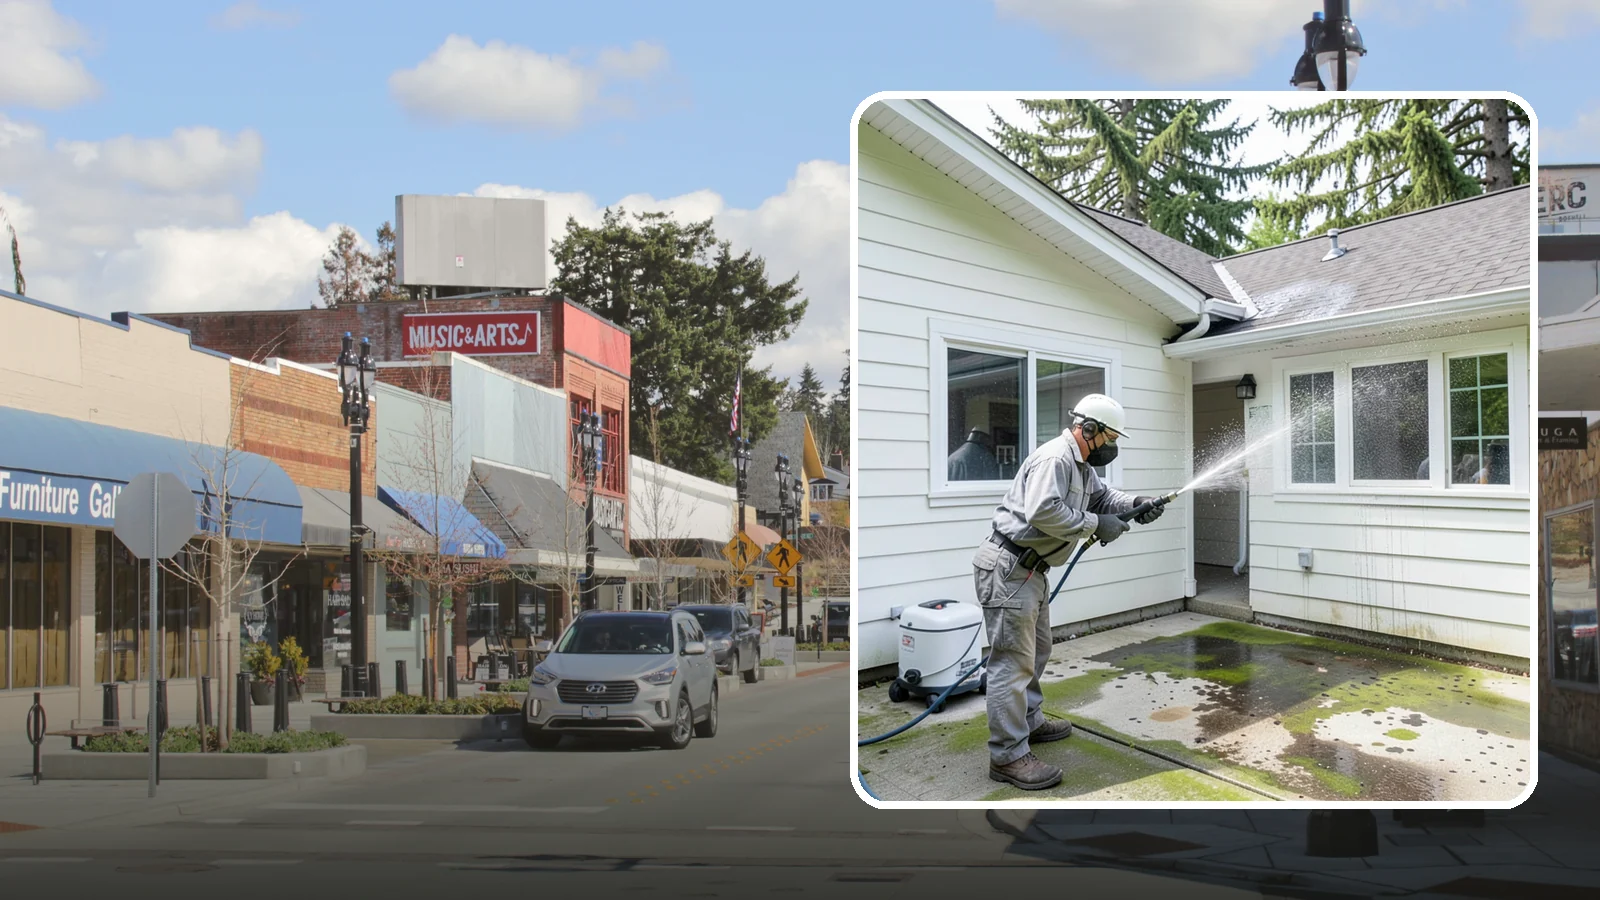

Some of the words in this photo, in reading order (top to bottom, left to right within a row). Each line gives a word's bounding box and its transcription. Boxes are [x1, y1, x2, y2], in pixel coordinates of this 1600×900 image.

[1538, 182, 1587, 213] ERC
[1540, 427, 1578, 437] UGA
[0, 471, 79, 515] Furniture
[89, 482, 122, 519] Gal
